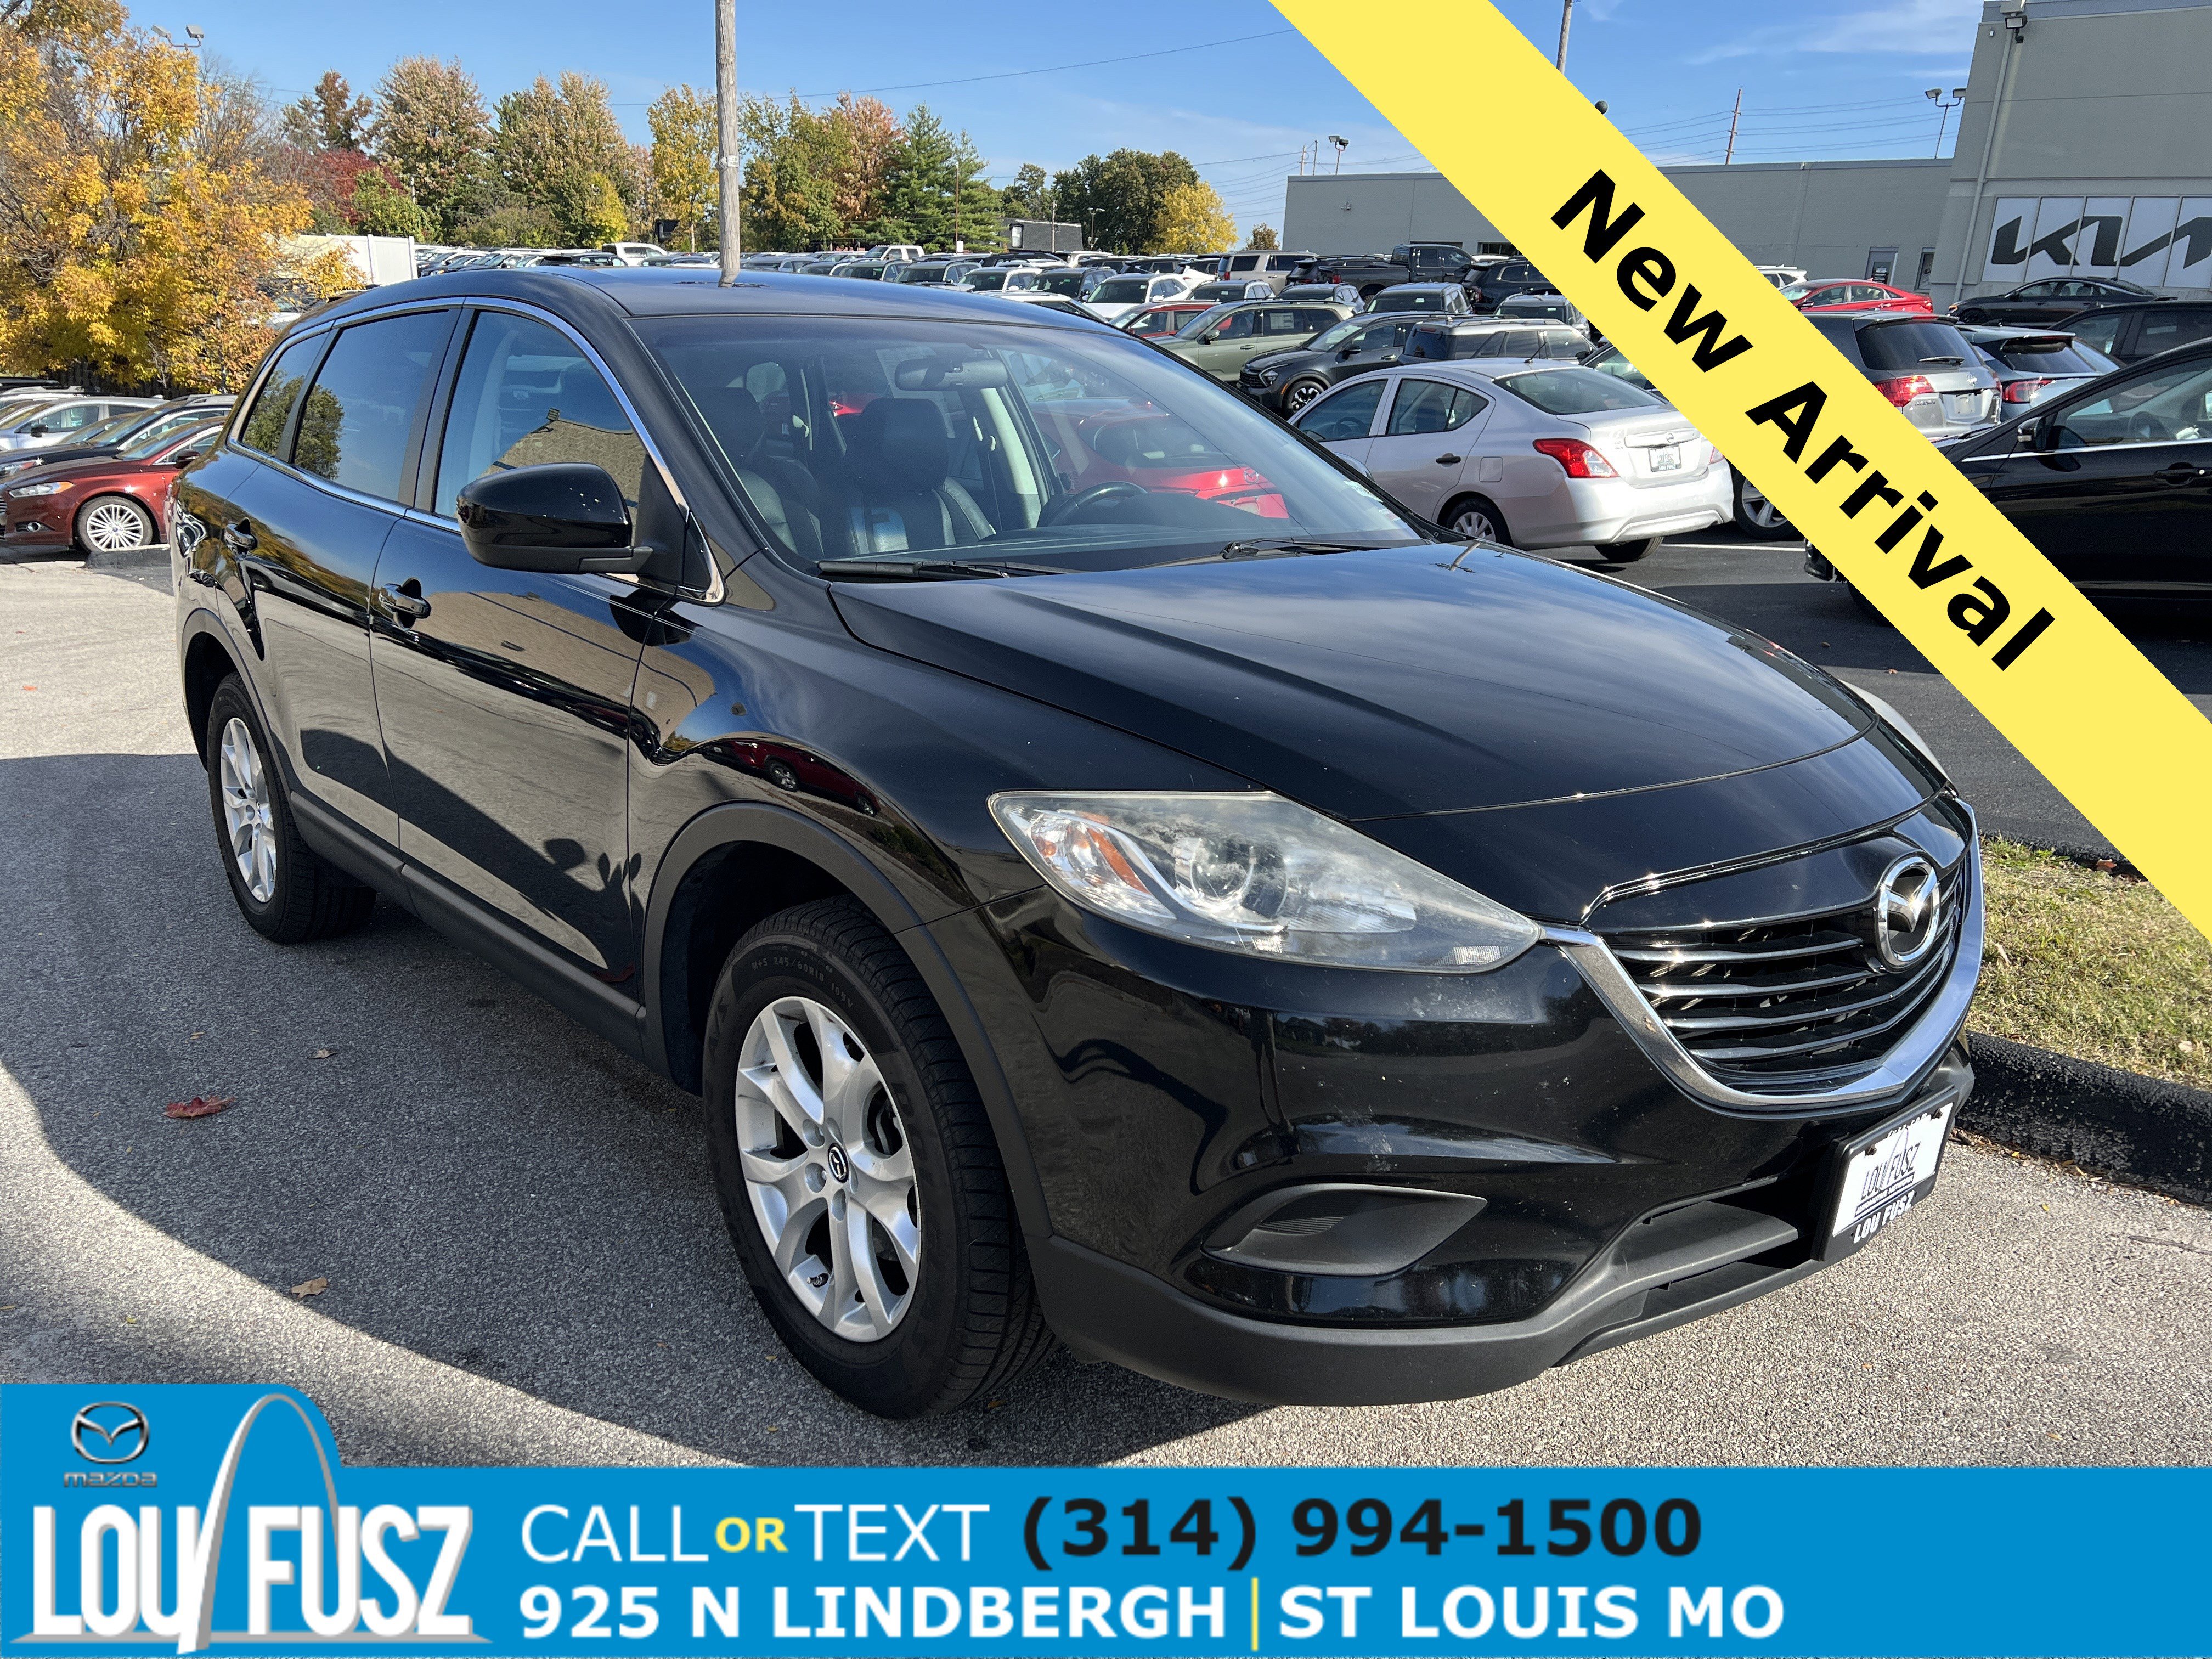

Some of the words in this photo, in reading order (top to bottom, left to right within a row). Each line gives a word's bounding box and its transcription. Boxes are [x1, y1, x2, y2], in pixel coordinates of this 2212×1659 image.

[1861, 1160, 1888, 1201] LOU
[1887, 1141, 1921, 1186] FUSZ
[1853, 1211, 1882, 1244] LOU
[1881, 1190, 1916, 1226] FUSZ
